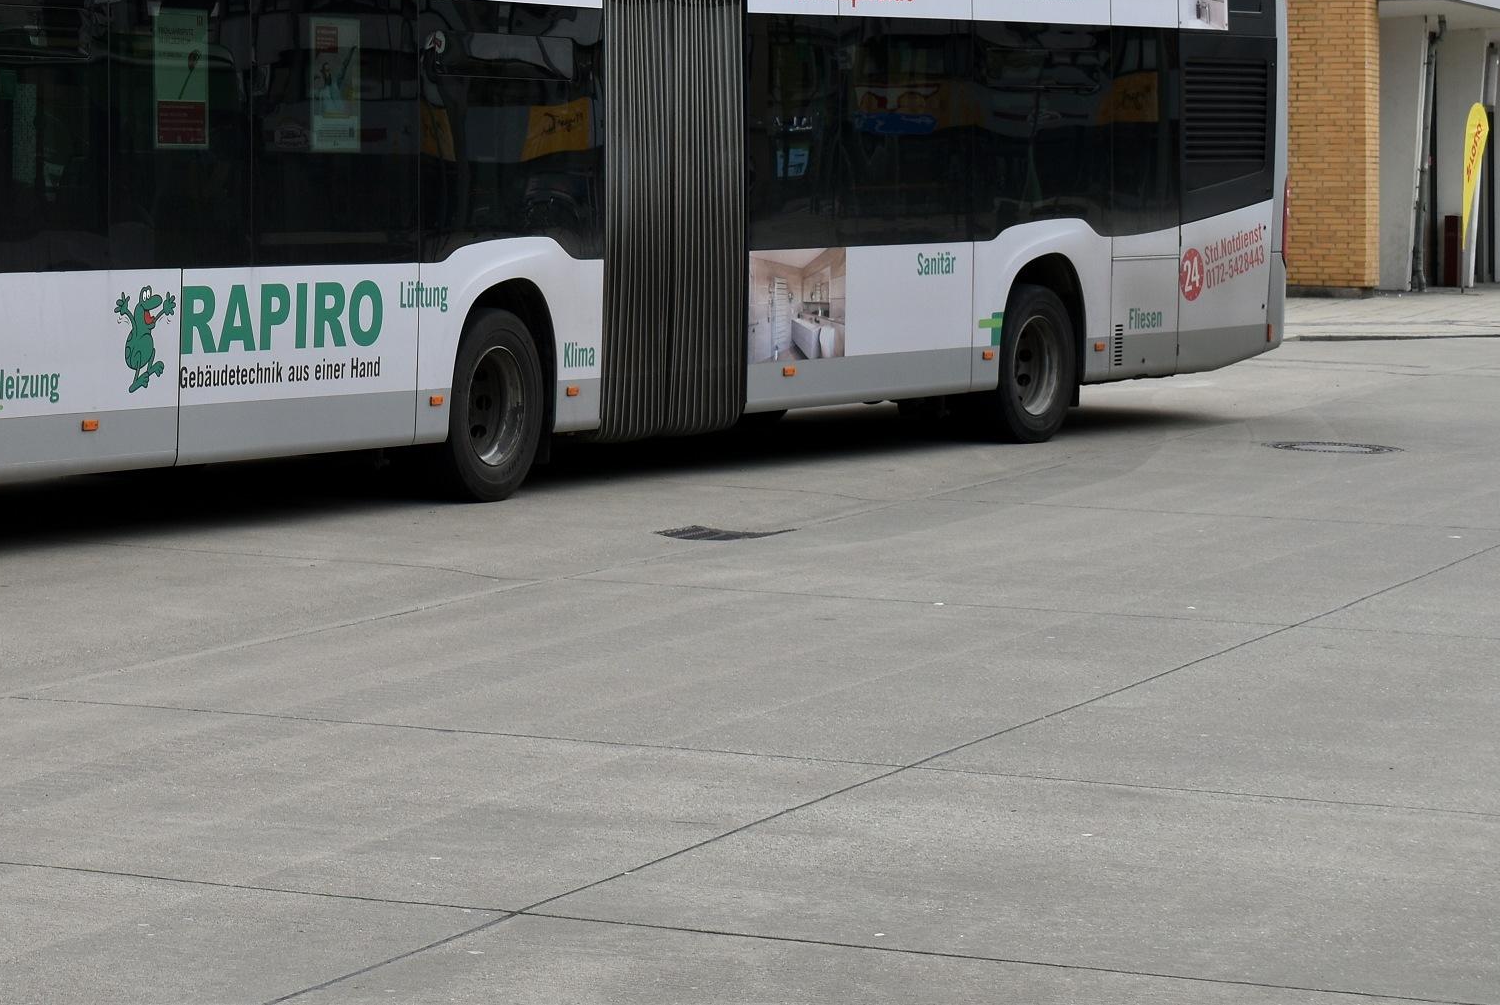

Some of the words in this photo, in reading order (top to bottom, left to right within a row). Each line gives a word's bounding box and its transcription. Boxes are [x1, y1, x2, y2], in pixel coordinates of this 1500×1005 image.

[917, 252, 956, 276] Sanitär
[1183, 257, 1200, 292] 24
[1206, 245, 1265, 289] 0172-5428443
[400, 281, 448, 312] Lüftung
[181, 280, 383, 355] RAPIRO
[1129, 308, 1163, 330] Fliesen
[563, 342, 595, 368] Klima
[180, 362, 283, 389] Gebäudetechnik
[288, 362, 309, 382] aus
[315, 360, 346, 381] einer
[351, 356, 381, 378] Hand
